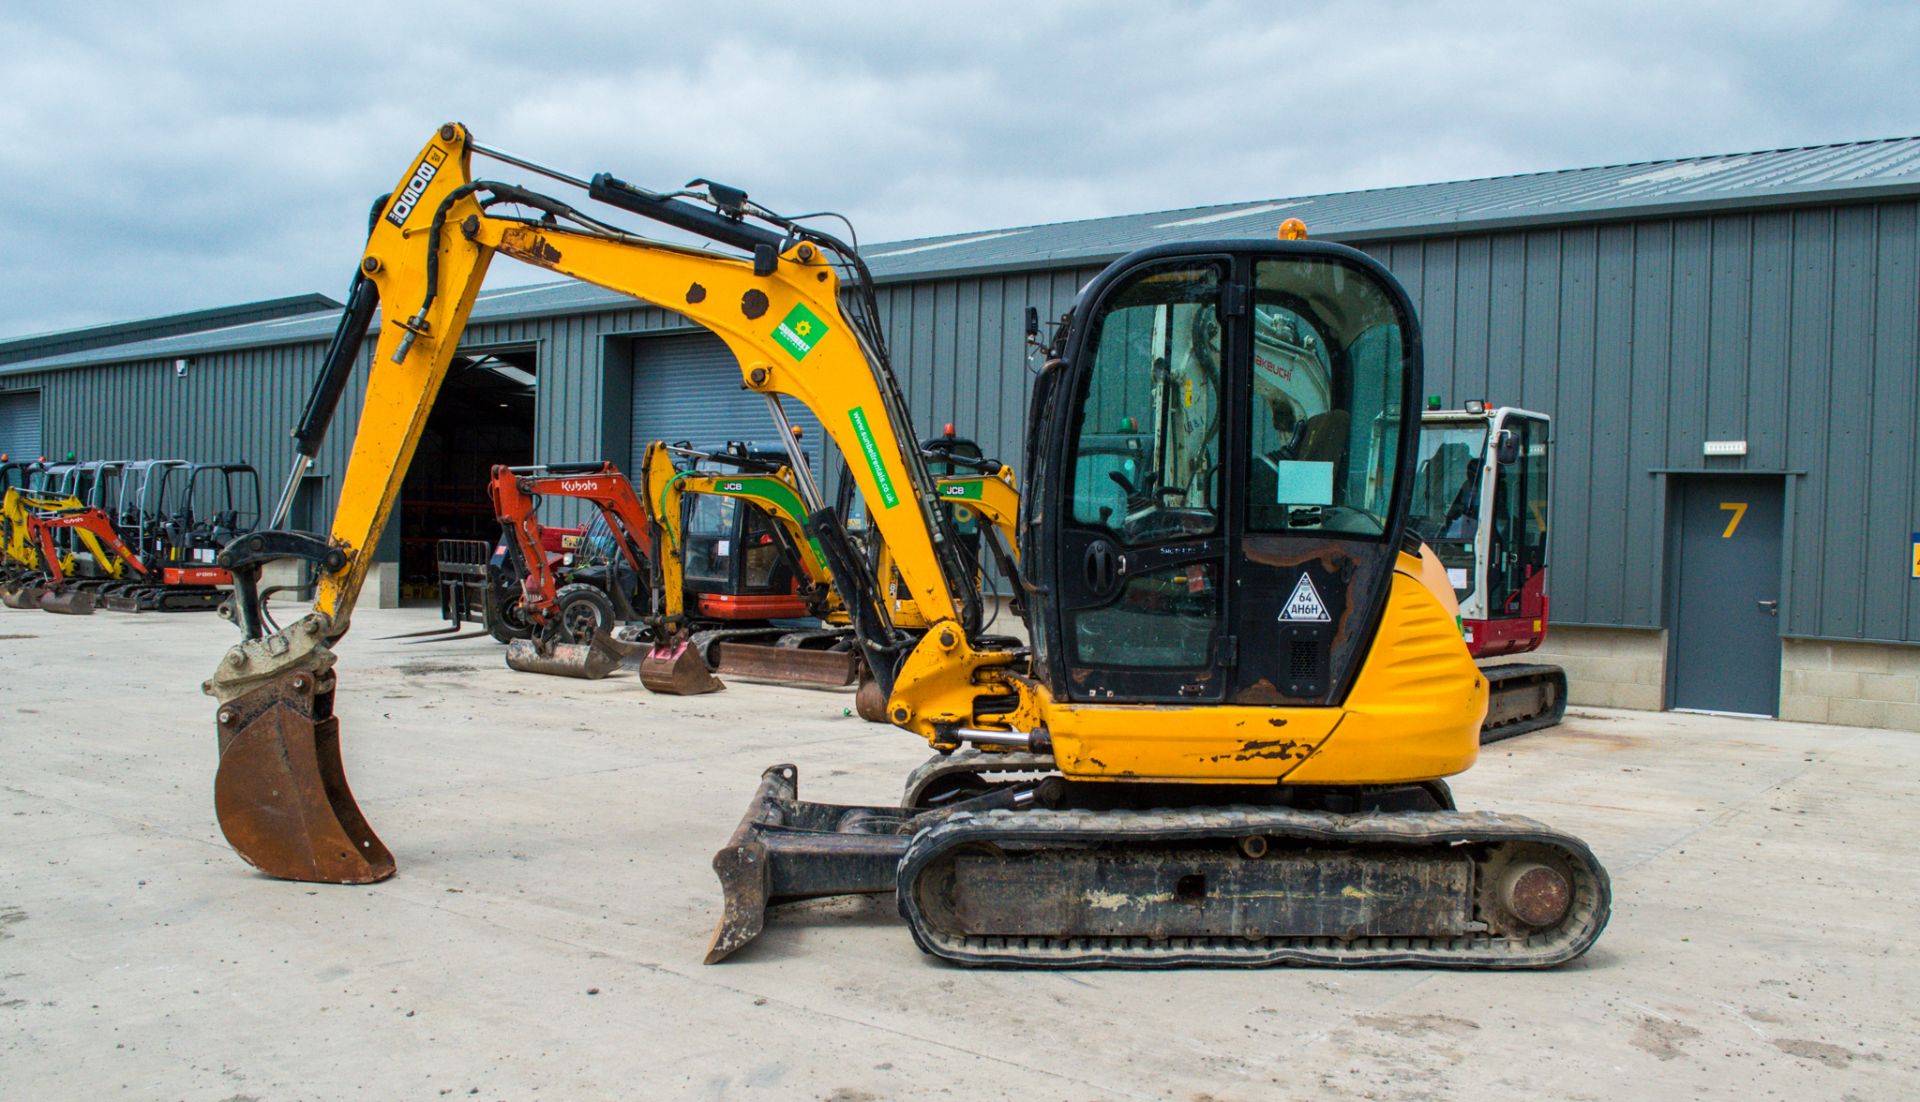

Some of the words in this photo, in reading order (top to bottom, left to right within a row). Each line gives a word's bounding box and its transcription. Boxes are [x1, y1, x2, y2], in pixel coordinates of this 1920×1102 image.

[392, 161, 437, 219] 8050
[853, 411, 895, 504] www.sunbeltrentals.co.uk
[561, 480, 598, 491] Kubota
[724, 483, 742, 491] JCB
[946, 486, 964, 495] JCB
[1719, 503, 1748, 538] 7
[1299, 592, 1312, 602] 64
[1291, 604, 1318, 614] AH6H
